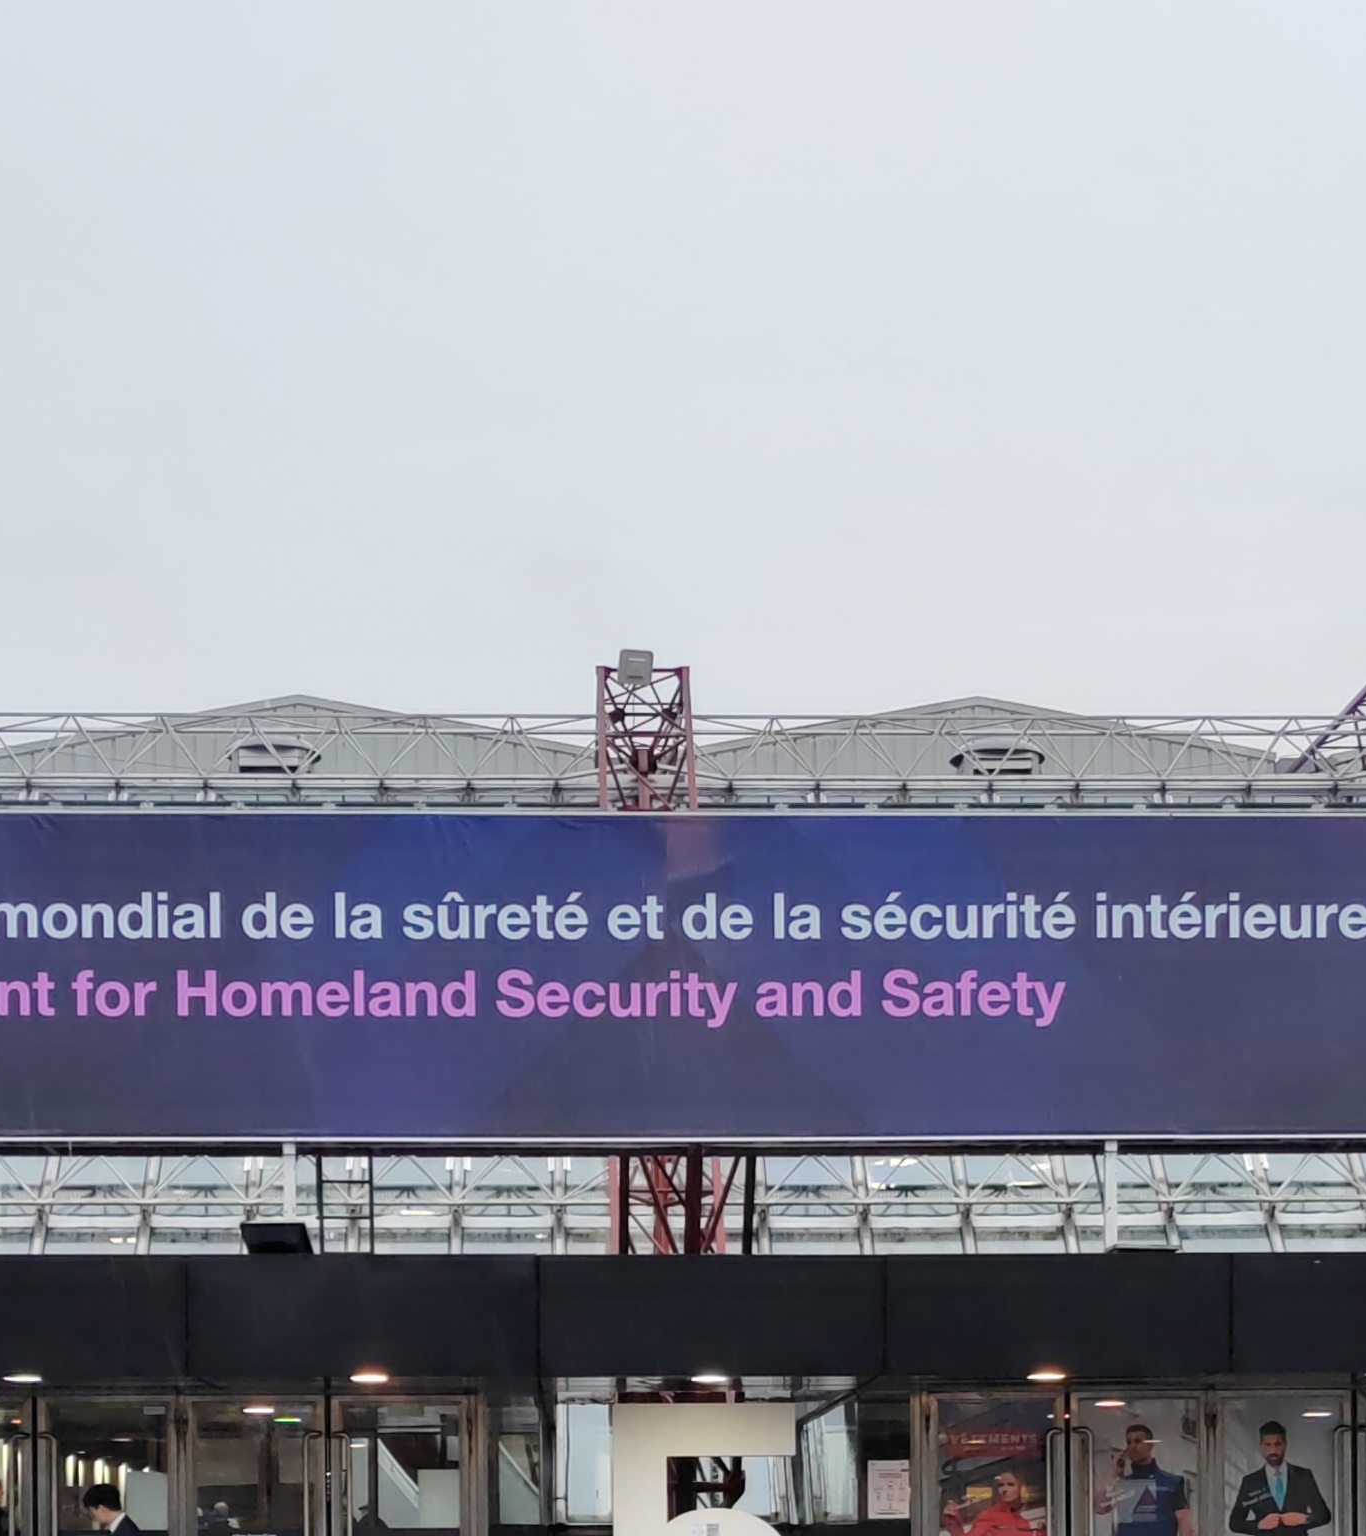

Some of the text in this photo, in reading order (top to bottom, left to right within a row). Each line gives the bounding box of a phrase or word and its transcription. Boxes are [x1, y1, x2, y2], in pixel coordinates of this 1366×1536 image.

[241, 891, 315, 940] de
[334, 891, 383, 940] la
[402, 891, 589, 940] sûreté
[607, 894, 665, 940] et
[681, 892, 754, 941] de
[773, 892, 821, 940] la
[840, 891, 1077, 940] sécurité
[71, 969, 157, 1017] for
[176, 969, 476, 1017] Homeland
[496, 969, 738, 1028] Security
[755, 970, 862, 1017] and
[881, 968, 1066, 1027] Safety
